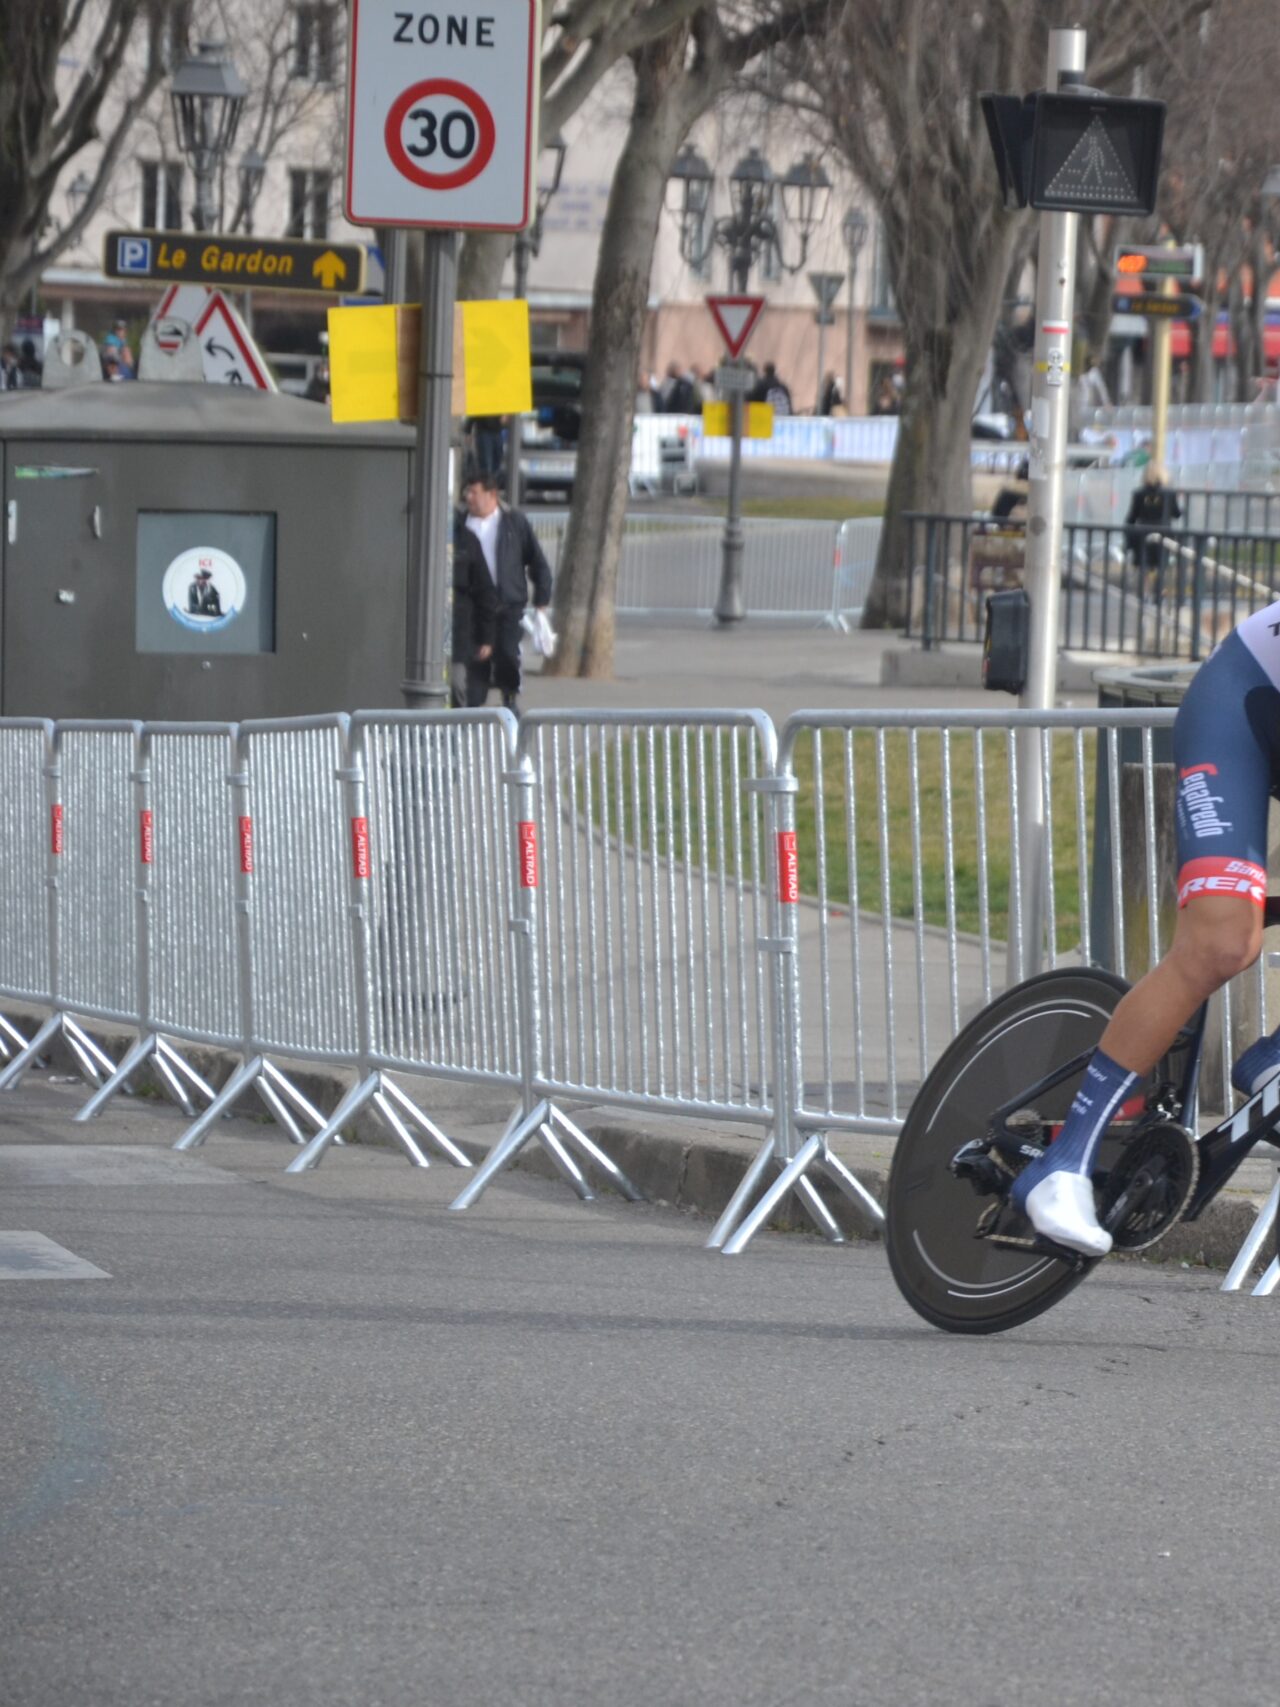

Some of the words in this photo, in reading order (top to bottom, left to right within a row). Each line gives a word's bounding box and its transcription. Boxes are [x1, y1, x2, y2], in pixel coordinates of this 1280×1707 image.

[393, 12, 495, 47] ZONE
[406, 108, 475, 159] 30
[123, 243, 144, 271] P
[157, 243, 187, 269] Le
[200, 245, 293, 275] Gardon
[1180, 763, 1232, 838] Segafredo
[357, 834, 367, 875] ALTRAD
[525, 840, 535, 884] ALTRAD
[787, 852, 798, 899] ALTRAD
[1177, 876, 1265, 901] REK
